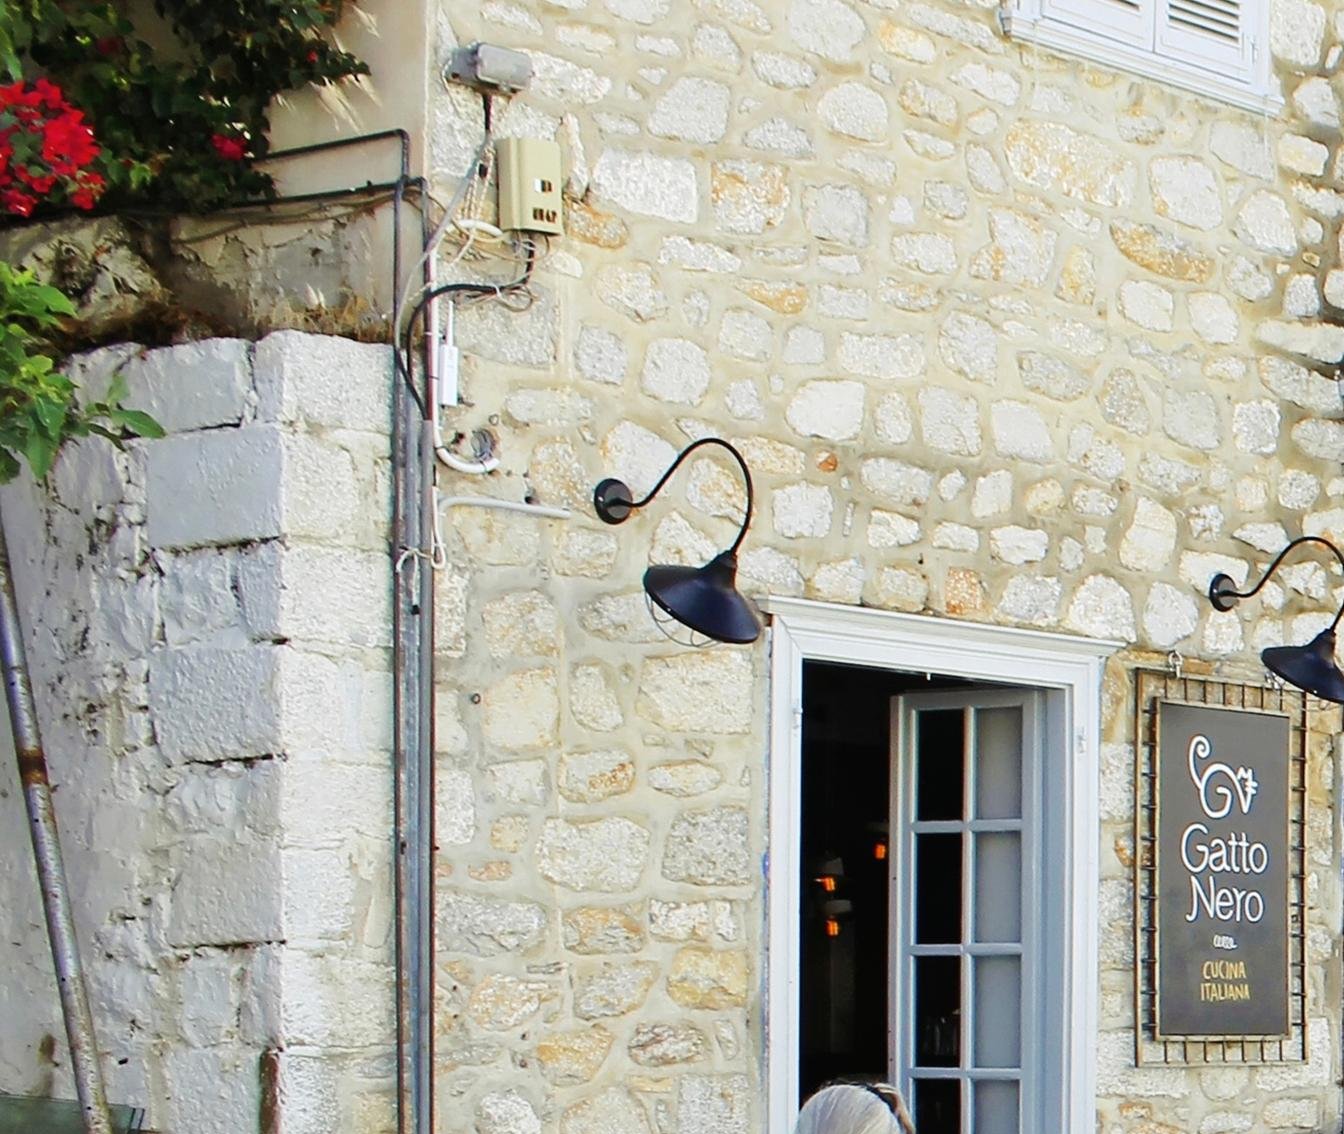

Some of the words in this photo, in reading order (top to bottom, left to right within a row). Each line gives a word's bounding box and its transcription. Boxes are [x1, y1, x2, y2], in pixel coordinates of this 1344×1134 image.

[1182, 823, 1267, 873] Gatto
[1186, 876, 1264, 922] Nero
[1202, 960, 1247, 980] CUCINA
[1200, 982, 1250, 1002] ITALIANA
